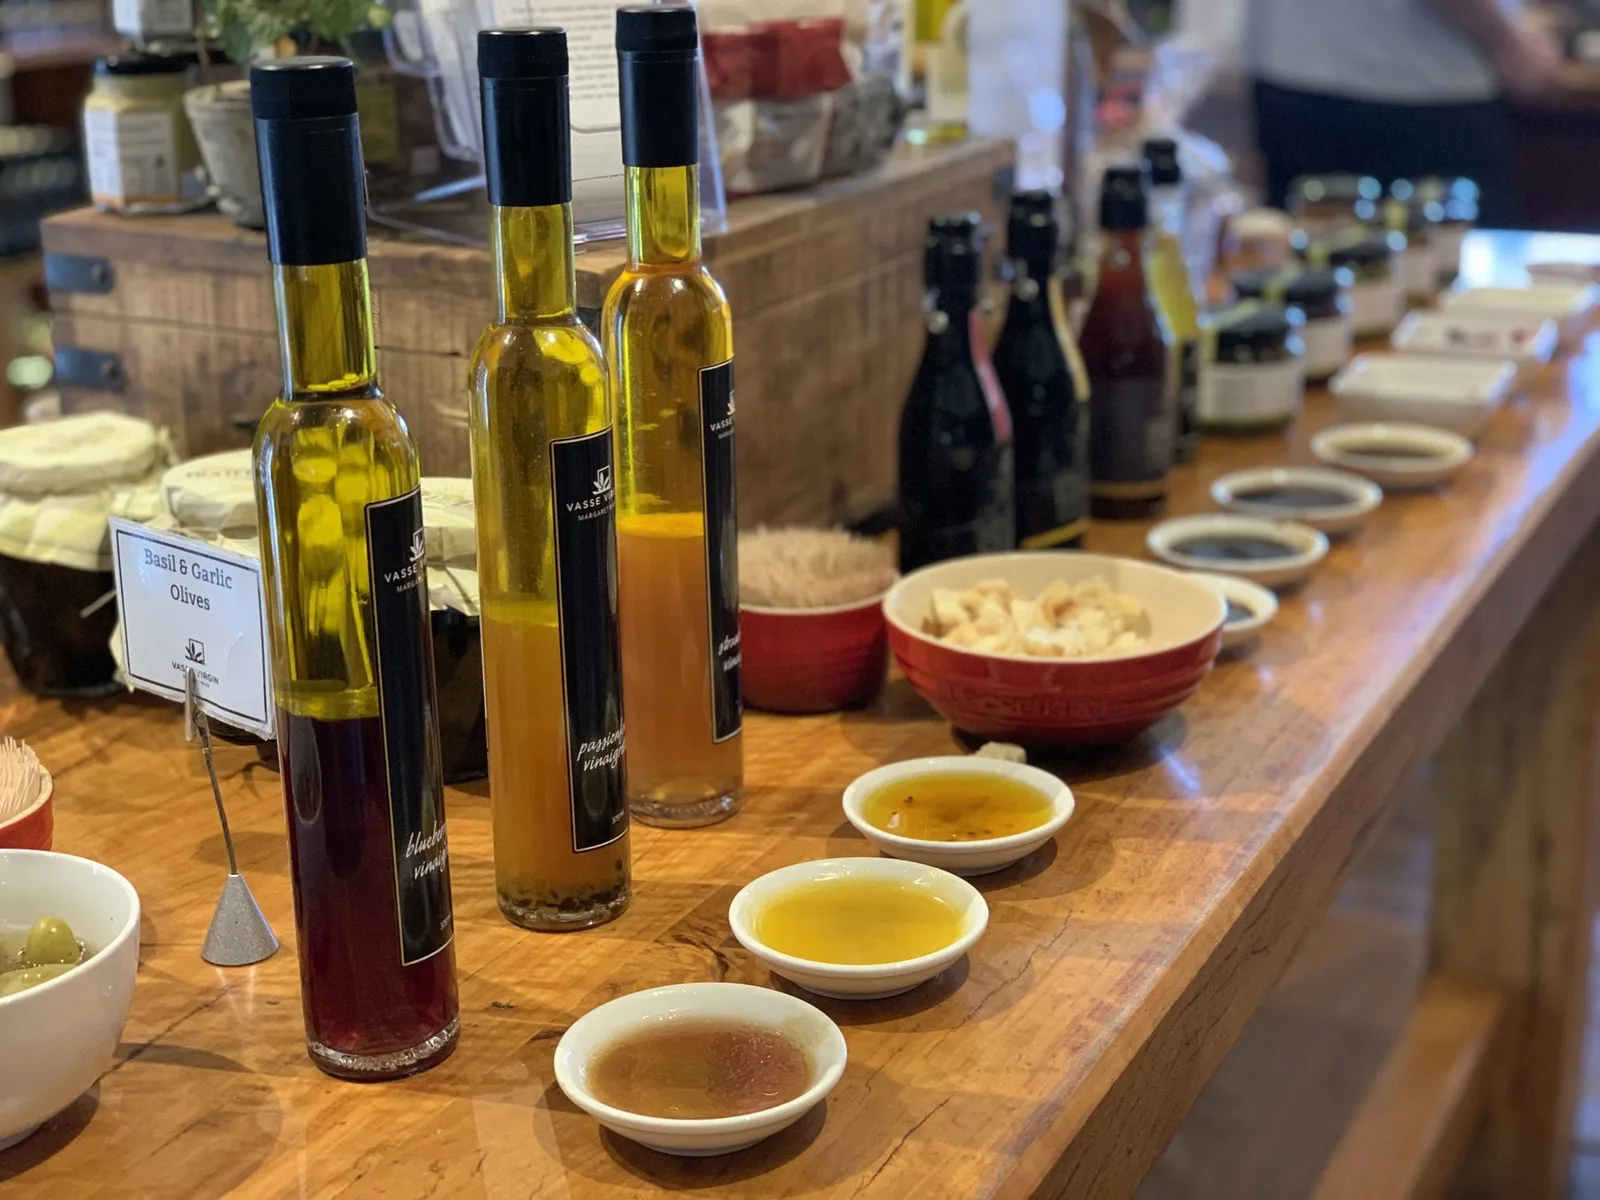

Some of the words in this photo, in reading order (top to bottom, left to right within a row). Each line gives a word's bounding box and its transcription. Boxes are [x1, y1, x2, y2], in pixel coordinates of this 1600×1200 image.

[710, 416, 732, 432] VASSE
[566, 496, 601, 512] VASSE
[144, 549, 177, 573] Basil
[180, 560, 188, 575] &
[191, 564, 233, 589] Garlic
[384, 563, 418, 583] VASSE
[170, 584, 210, 611] Olives
